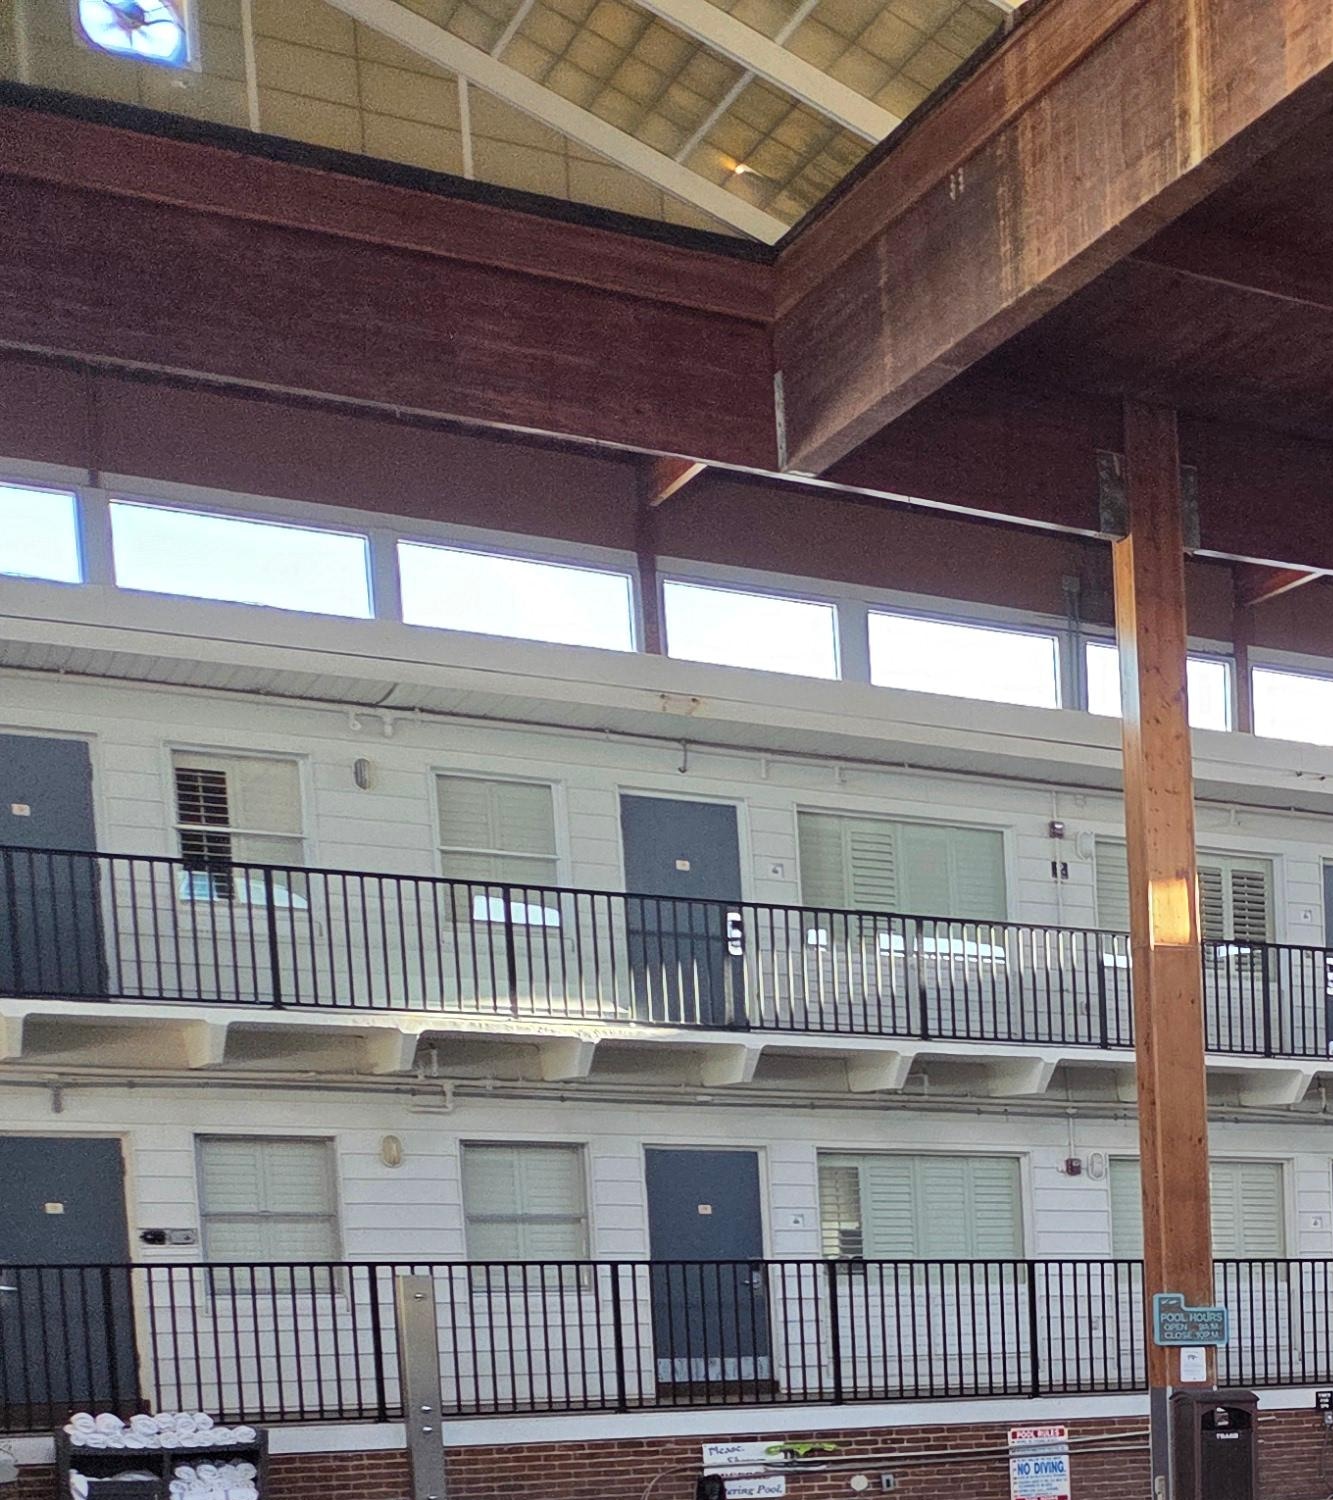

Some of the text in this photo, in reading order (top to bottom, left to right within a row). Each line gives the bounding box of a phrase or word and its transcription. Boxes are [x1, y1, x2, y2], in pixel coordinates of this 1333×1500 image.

[1161, 1312, 1223, 1322] POOL HOURS
[1163, 1323, 1188, 1331] OPEN
[1164, 1331, 1192, 1340] CLOSE
[1017, 1462, 1031, 1475] NO
